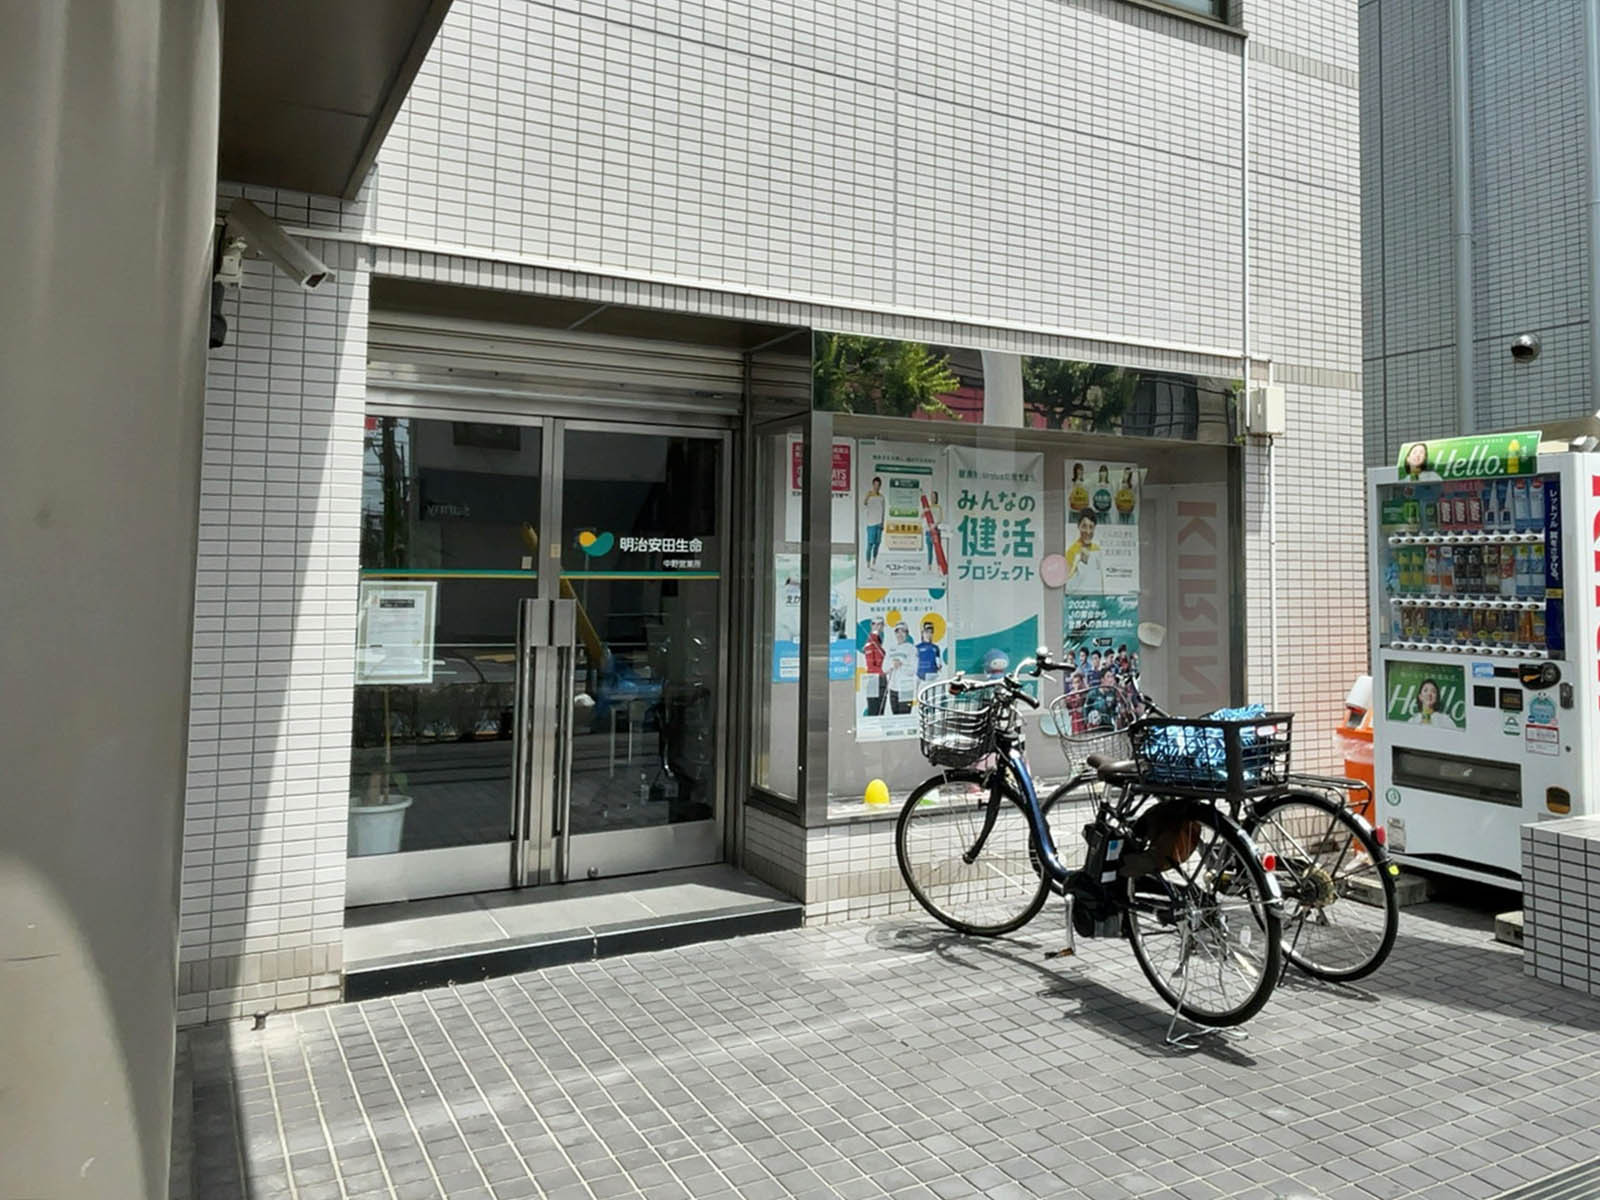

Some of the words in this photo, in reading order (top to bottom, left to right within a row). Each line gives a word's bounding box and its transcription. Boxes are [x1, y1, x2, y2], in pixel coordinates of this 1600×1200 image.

[957, 490, 1036, 512] みんなの
[620, 537, 703, 553] 明治安田生命
[957, 515, 1036, 559] 健活
[663, 559, 702, 569] 中野営業所
[957, 561, 1036, 582] プロジェクト
